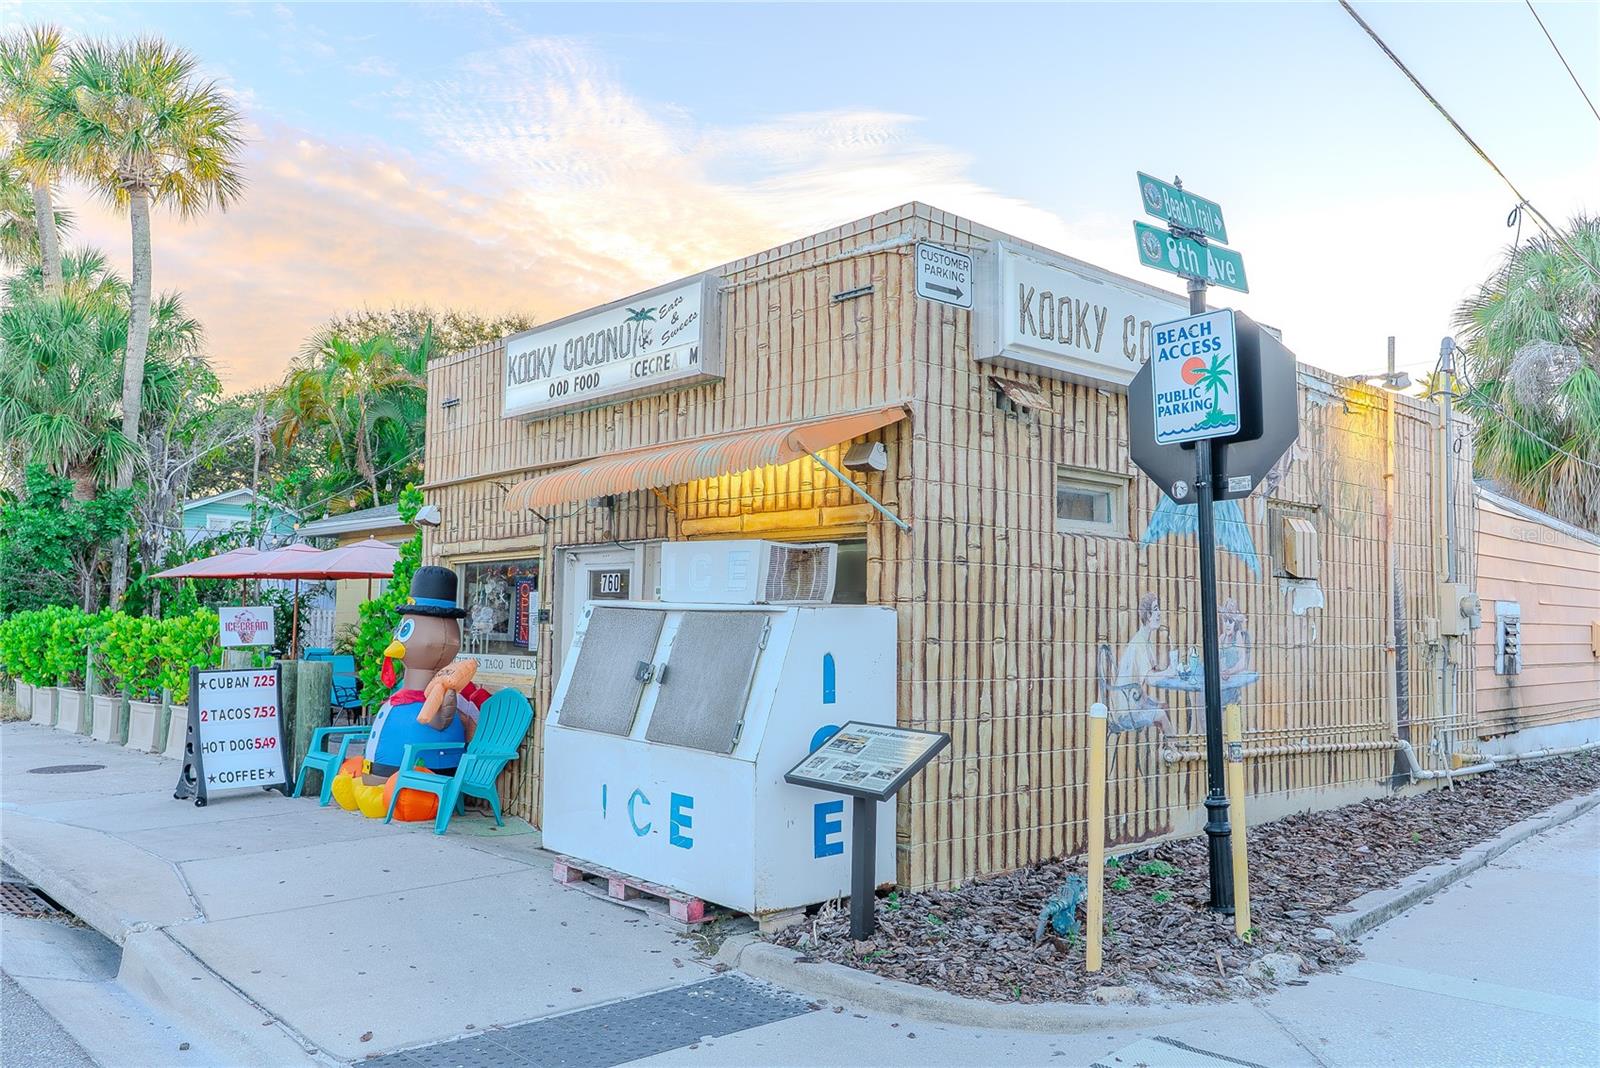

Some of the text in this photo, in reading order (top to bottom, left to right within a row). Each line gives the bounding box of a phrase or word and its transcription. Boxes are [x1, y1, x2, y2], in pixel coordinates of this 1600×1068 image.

[1162, 187, 1193, 225] Beach
[1192, 200, 1215, 234] Trail
[920, 249, 969, 271] CUSTOMER
[1166, 236, 1200, 274] 8th
[1206, 248, 1236, 283] Ave
[924, 263, 965, 283] PARKING
[659, 296, 684, 320] Eats
[670, 311, 679, 325] &
[1019, 283, 1108, 353] KOOKY
[661, 312, 698, 346] Sweets
[1156, 321, 1212, 346] BEACH
[1158, 336, 1222, 362] ACCESS
[508, 343, 558, 387] KOOKY
[549, 371, 600, 399] OOD FOOD
[1157, 386, 1202, 405] PUBLIC
[1158, 398, 1213, 418] PARKING
[602, 574, 620, 591] 760
[520, 583, 530, 640] OPEN
[225, 621, 269, 632] ICE CREAM
[485, 659, 504, 670] TACO
[209, 675, 275, 690] CUBAN 7.25
[200, 706, 276, 722] 2 TACOS 7.52
[201, 737, 276, 754] HOT DOG 5.49
[218, 769, 265, 783] COFFEE
[602, 784, 694, 850] ICE
